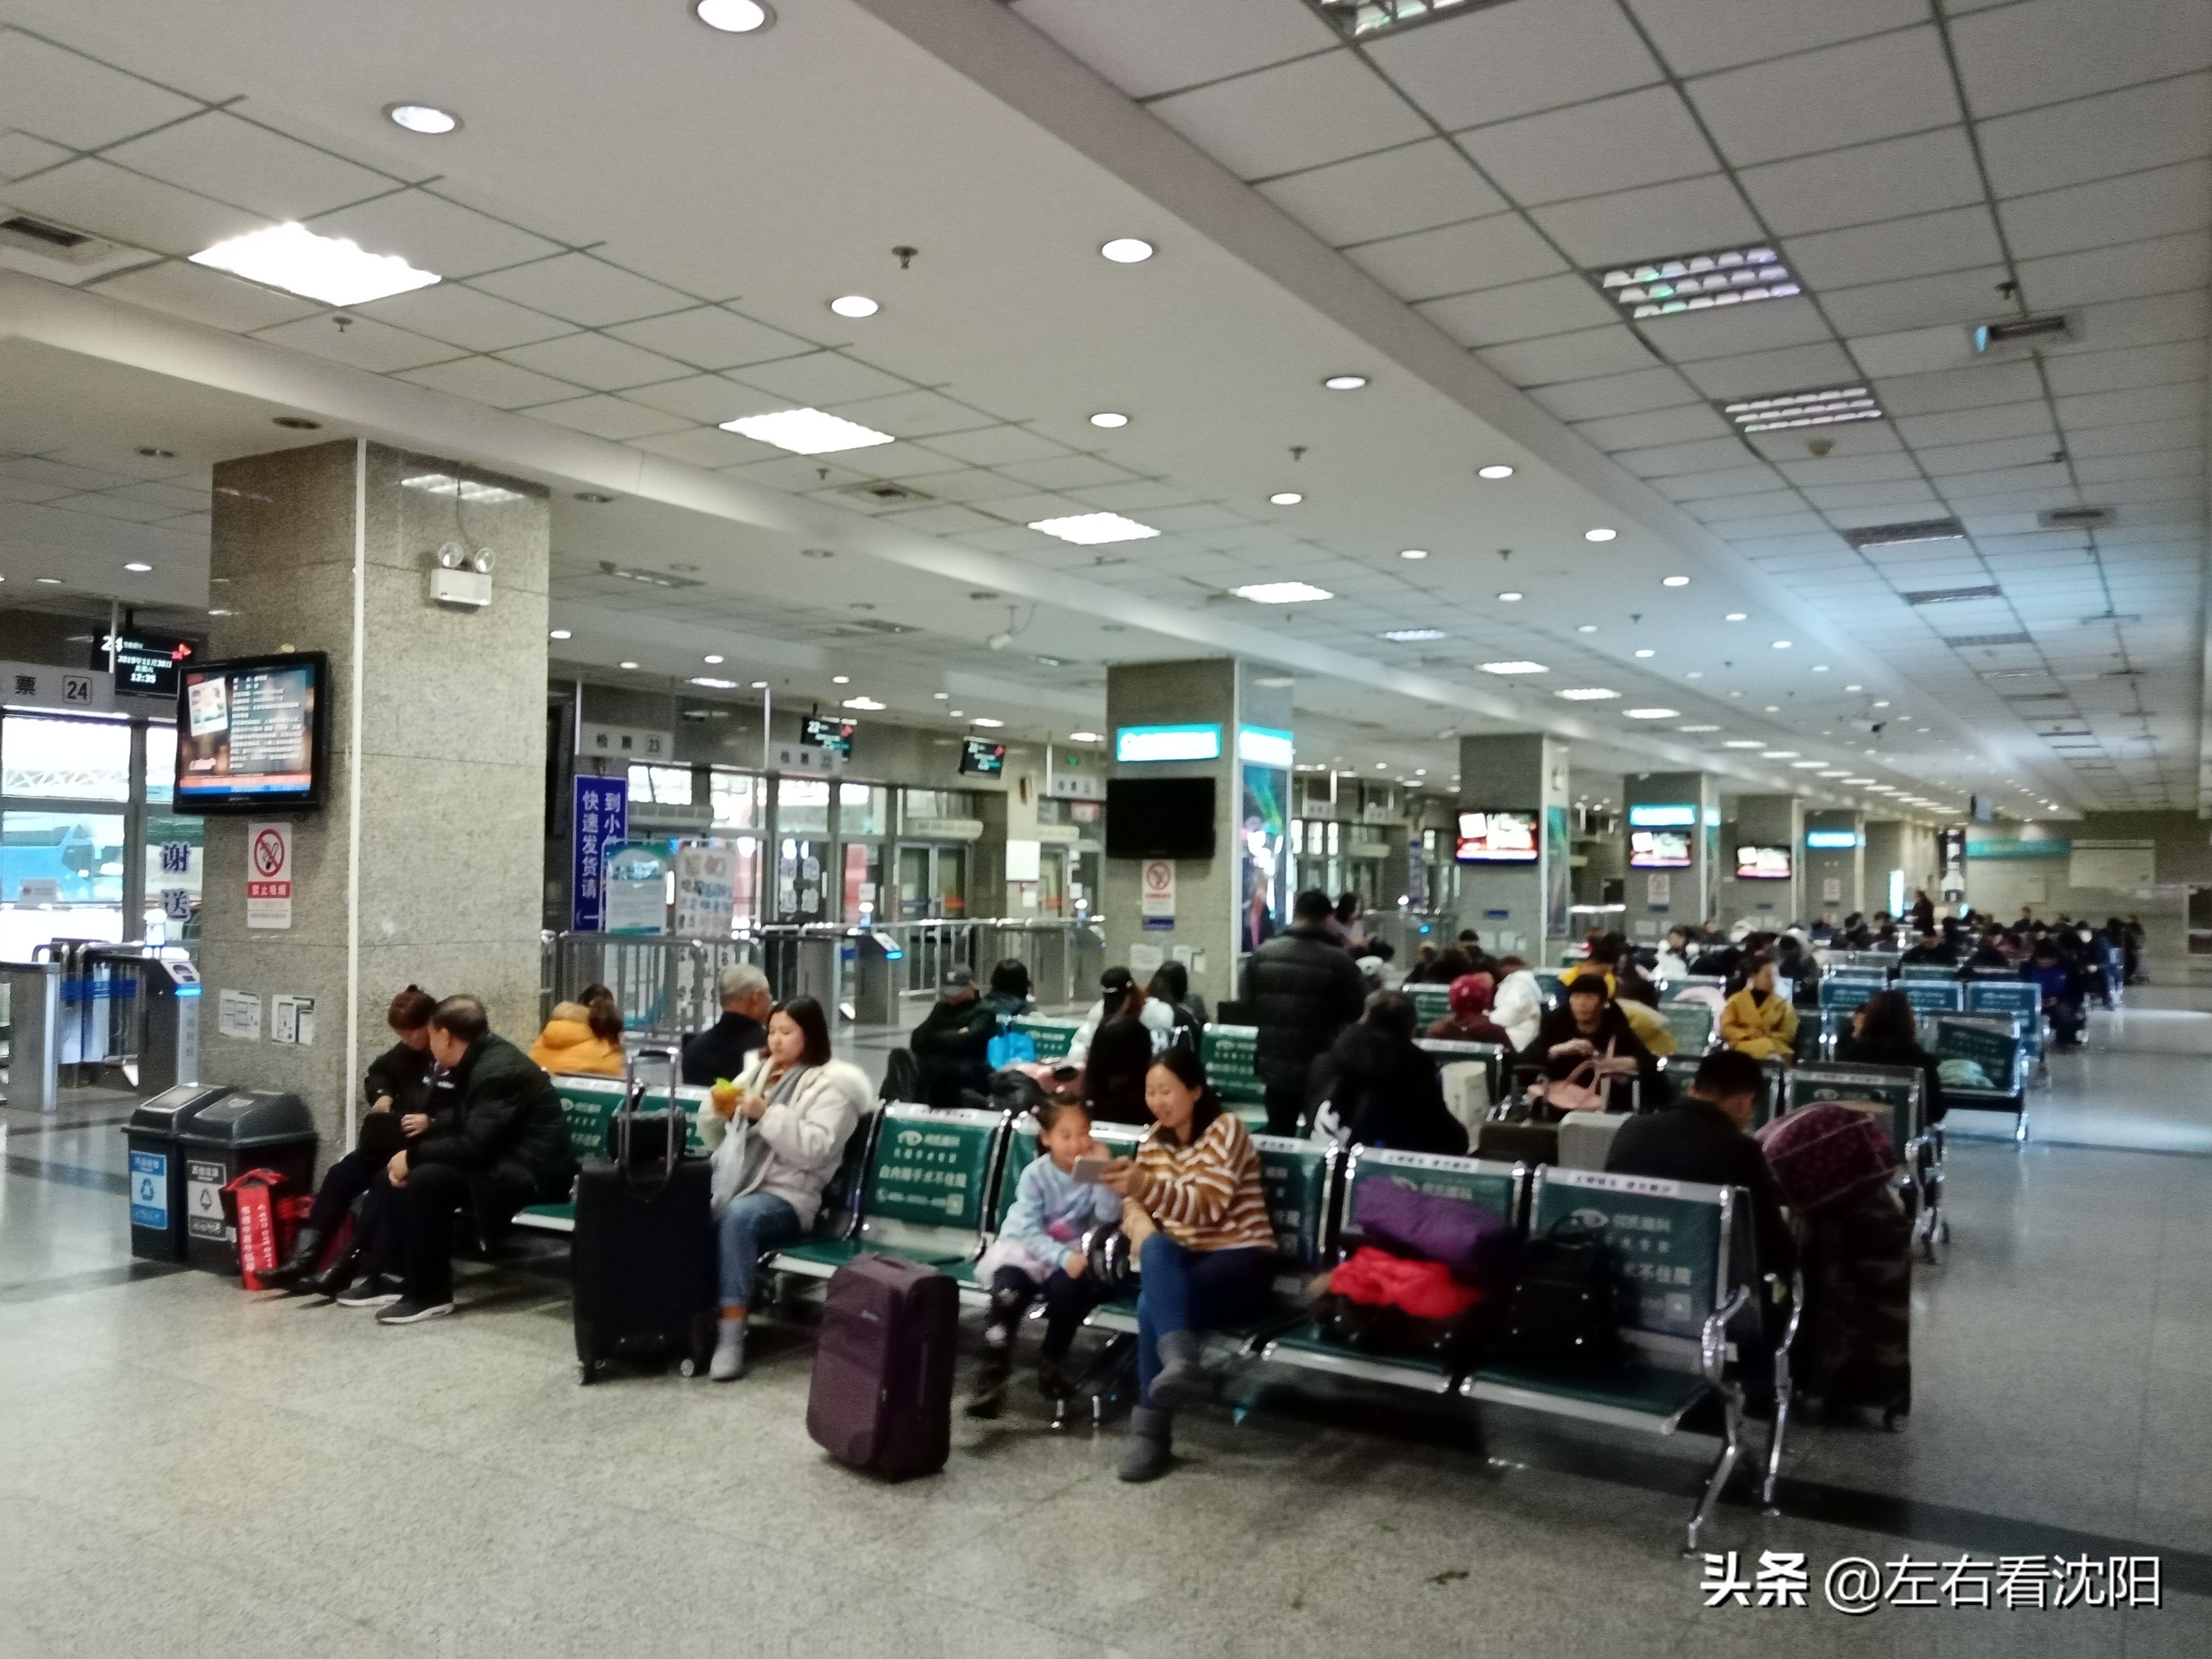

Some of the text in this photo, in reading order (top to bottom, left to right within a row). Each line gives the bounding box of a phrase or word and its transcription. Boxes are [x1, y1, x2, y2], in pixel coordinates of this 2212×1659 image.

[15, 675, 88, 700] 票 24
[604, 792, 621, 844] 到小
[163, 842, 190, 872] 谢
[164, 890, 189, 919] 送
